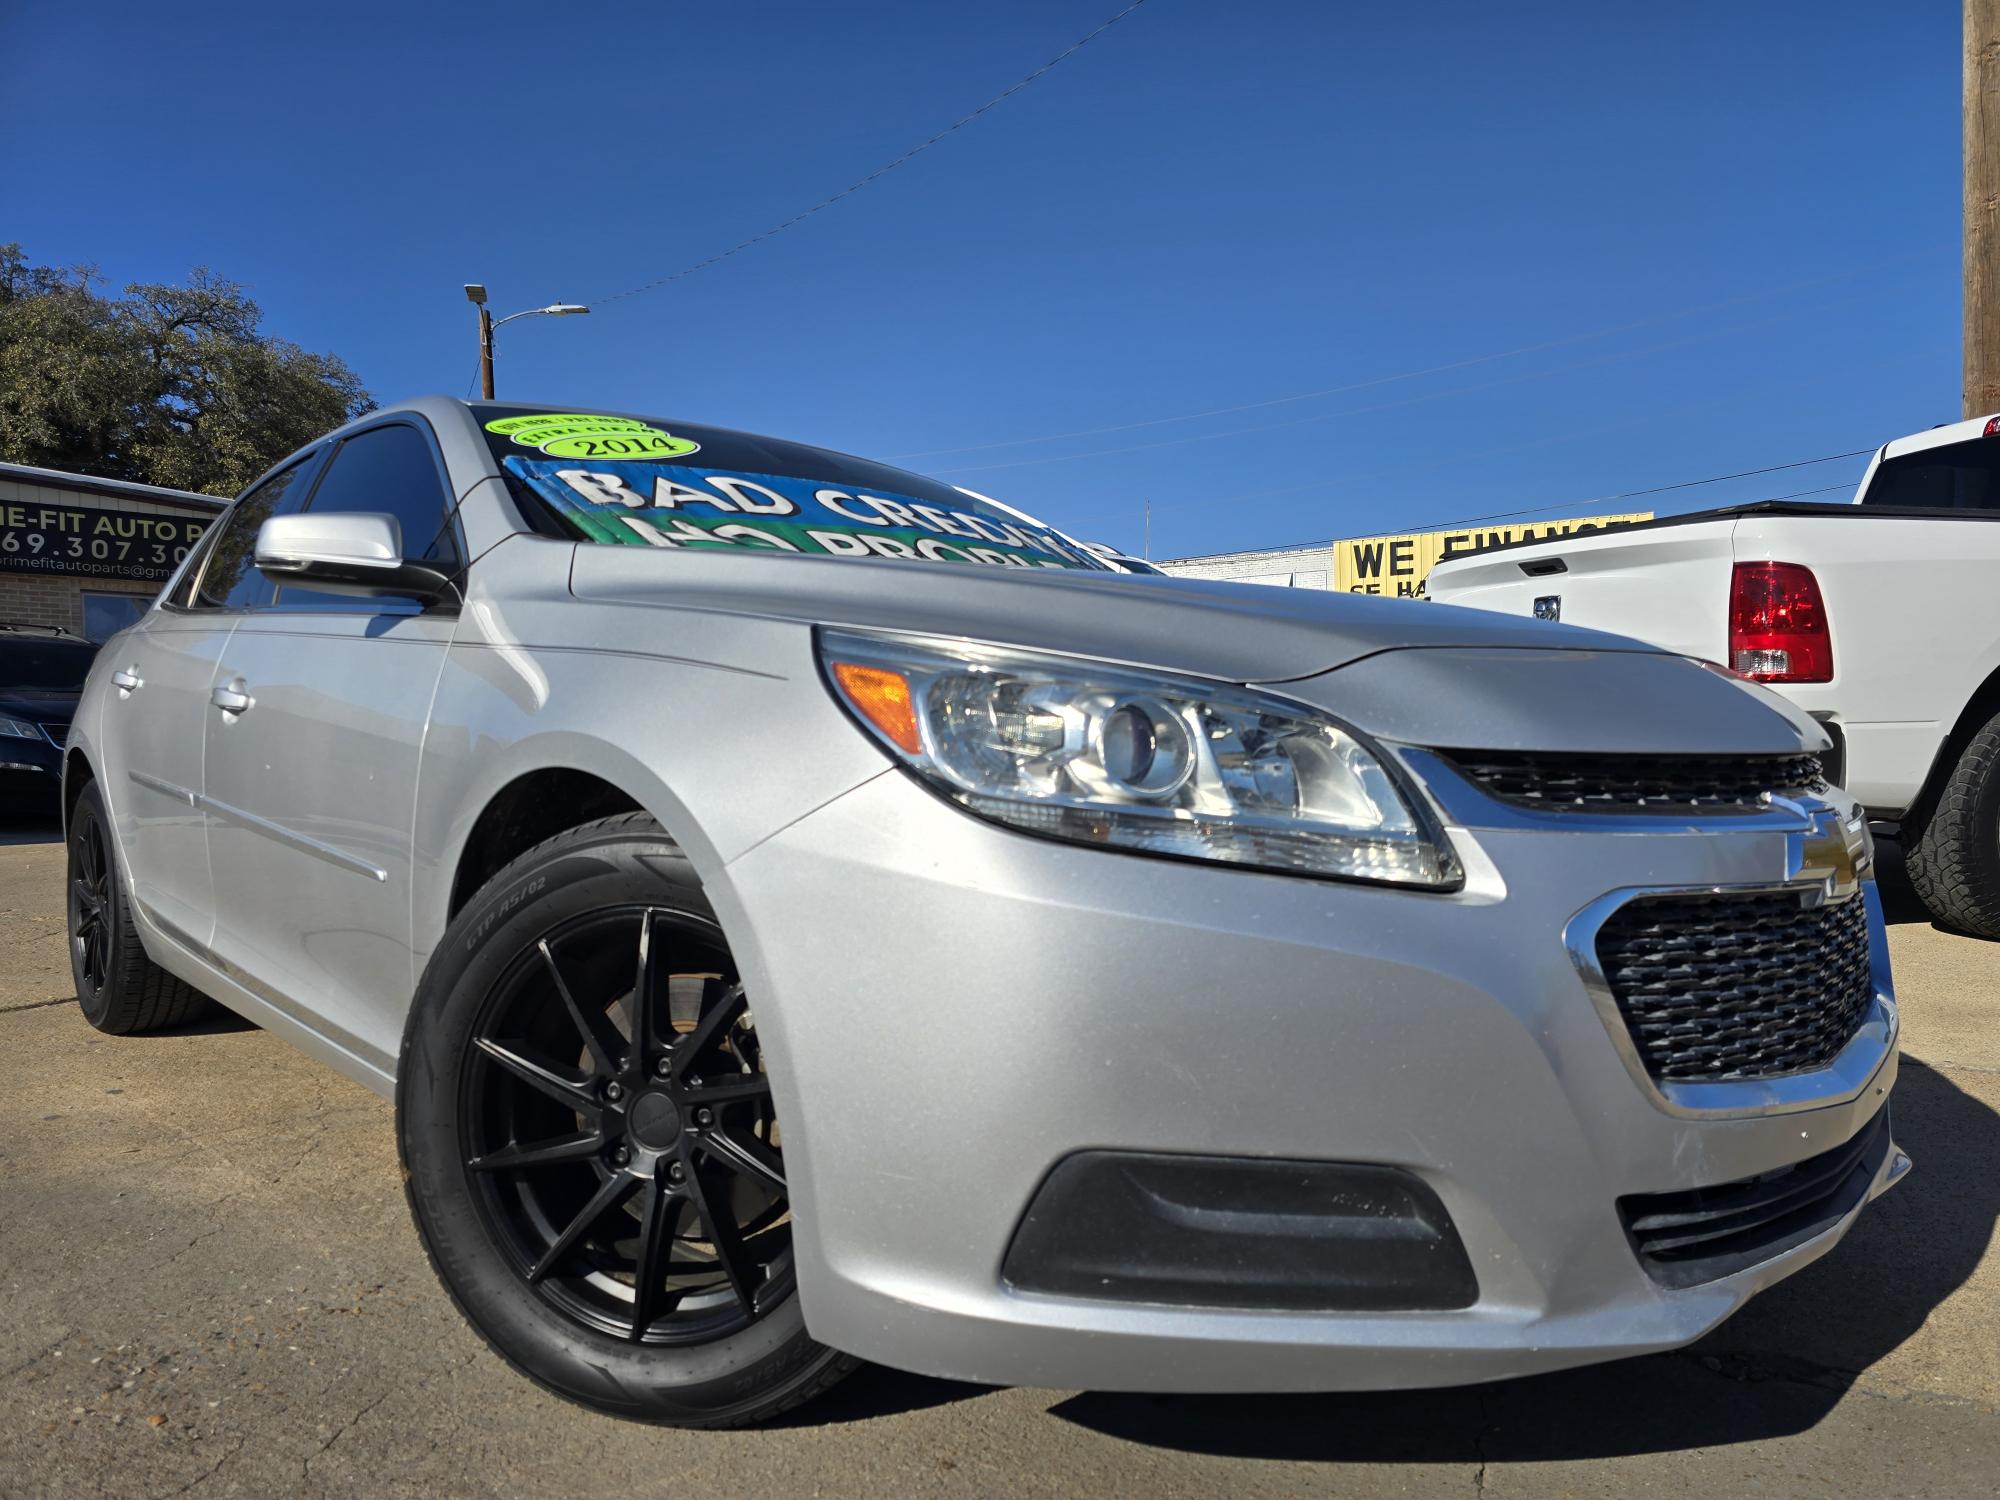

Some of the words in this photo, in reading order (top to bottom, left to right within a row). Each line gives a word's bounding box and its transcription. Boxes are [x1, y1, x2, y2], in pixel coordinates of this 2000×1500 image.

[521, 428, 579, 443] EXTRA
[573, 437, 679, 456] 2014
[554, 468, 796, 516] BAD
[93, 515, 177, 541] AUTO
[1353, 540, 1414, 579] WE
